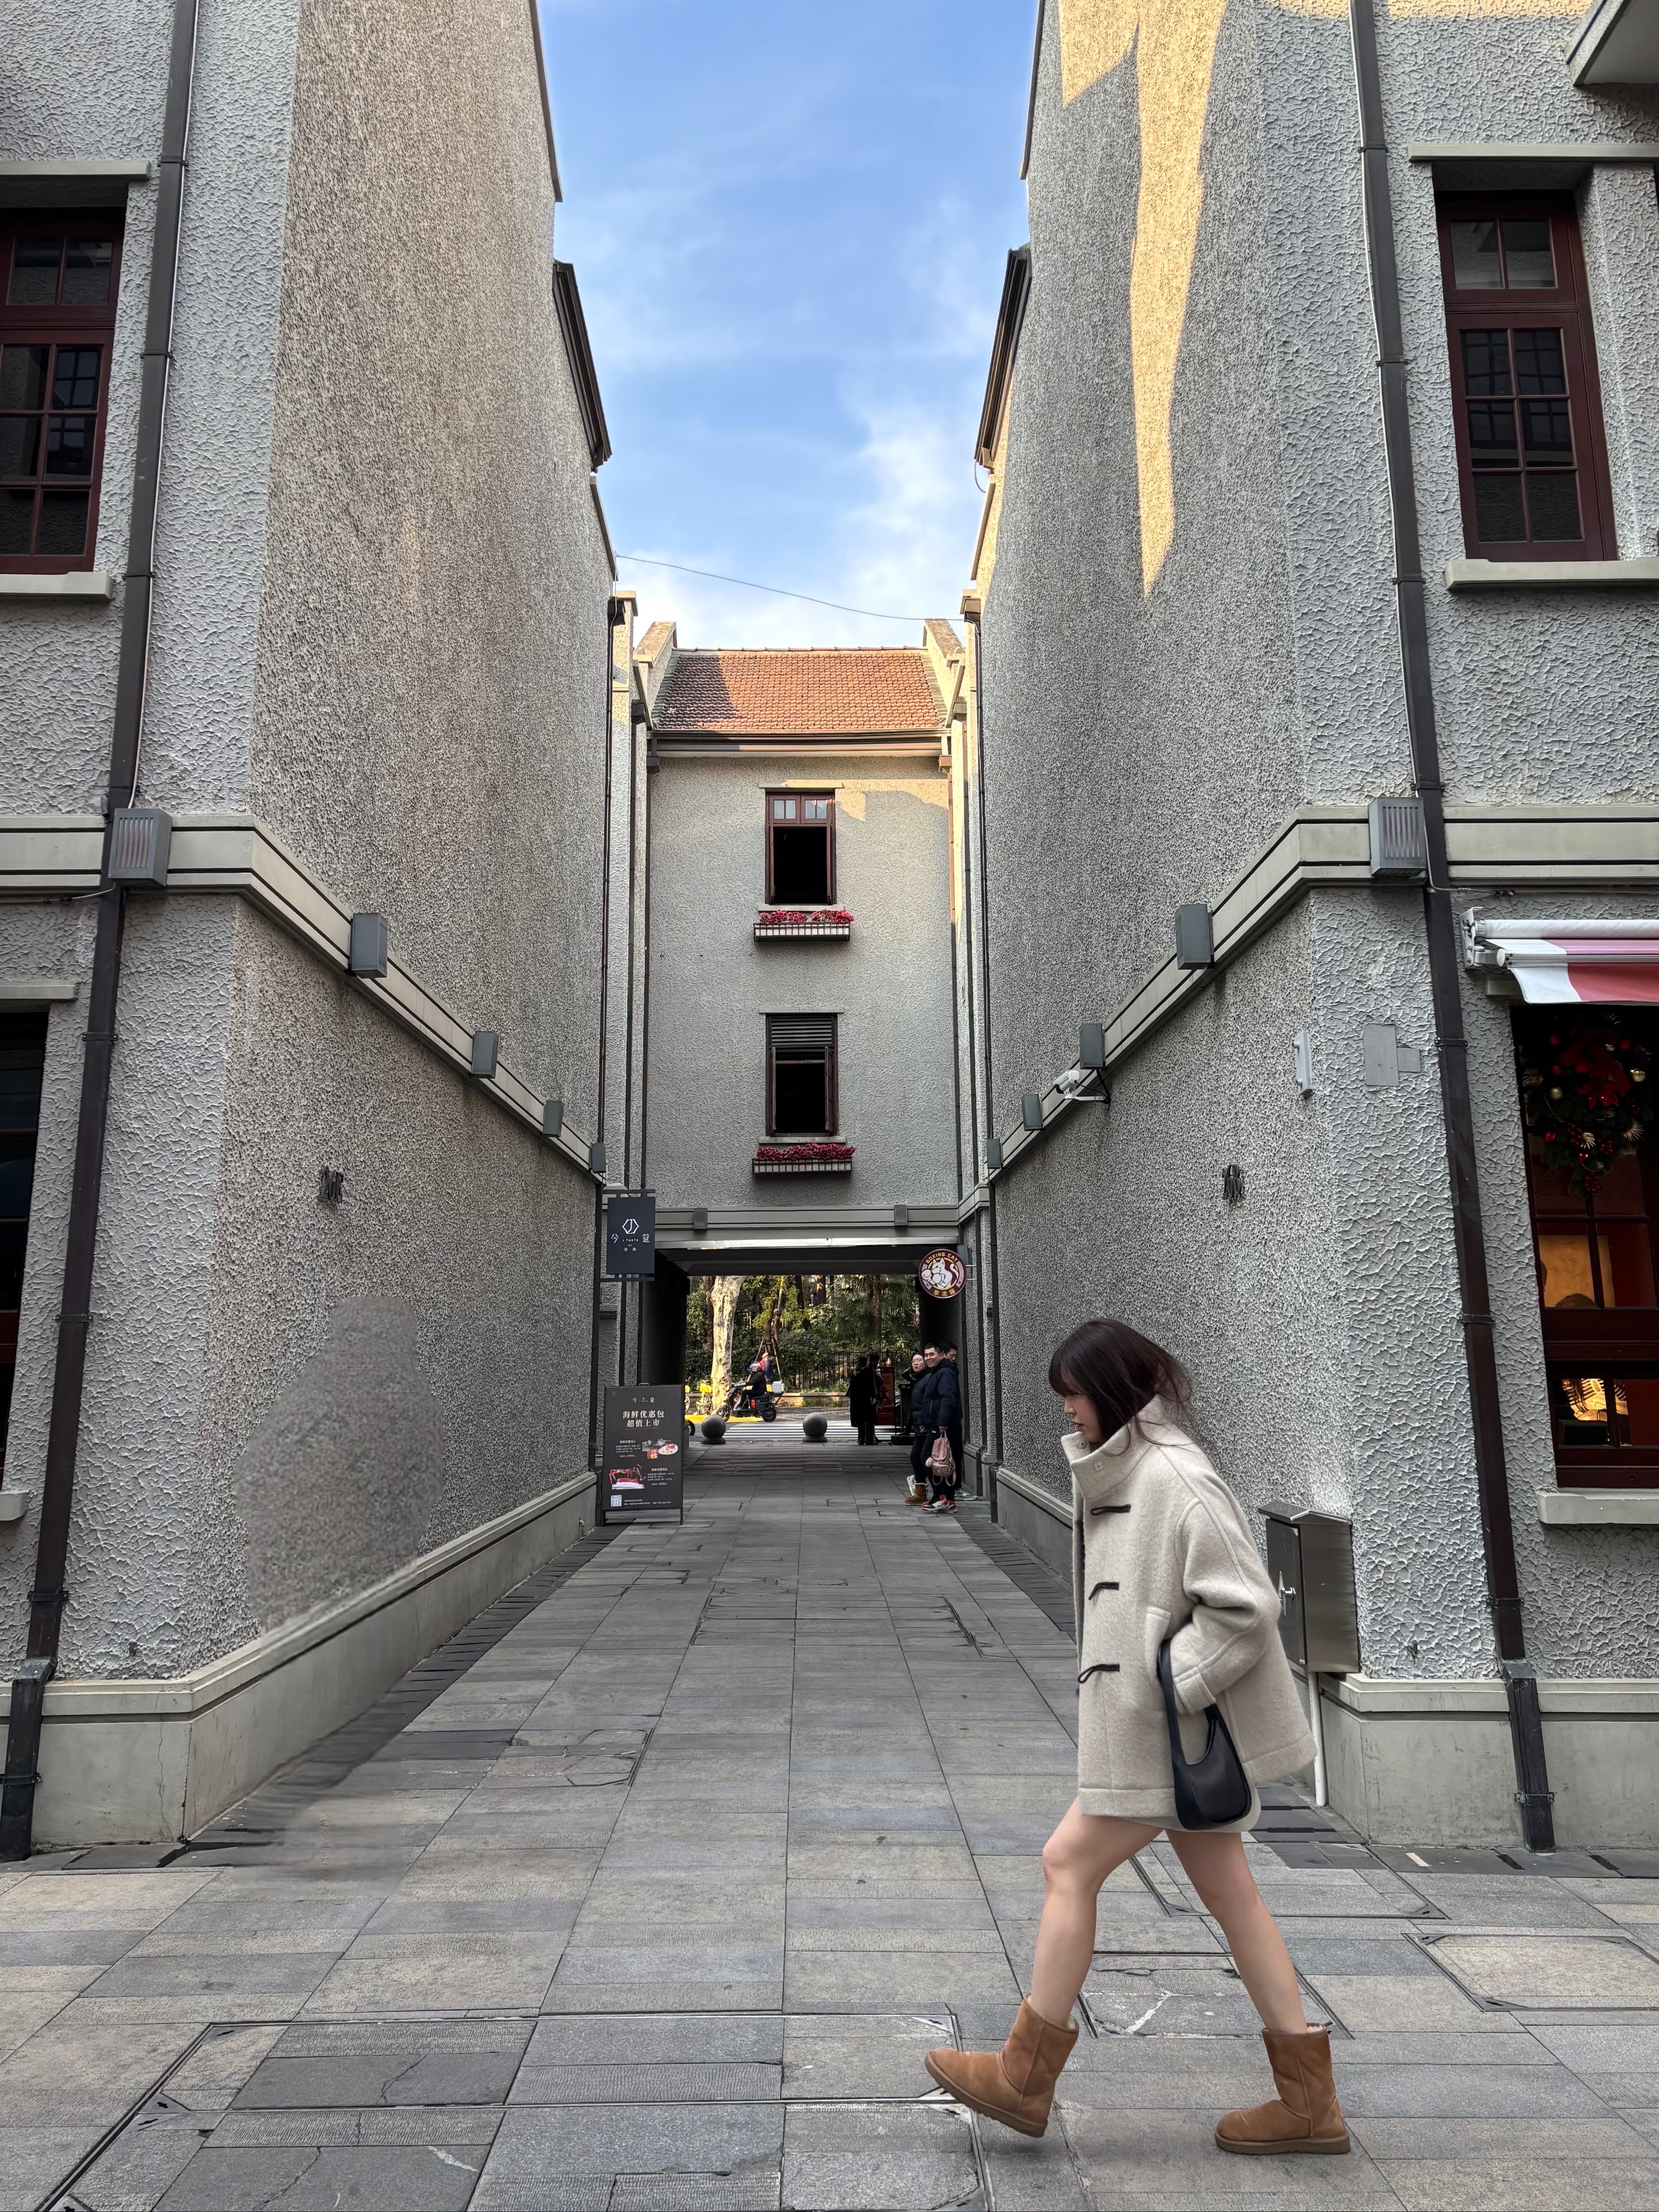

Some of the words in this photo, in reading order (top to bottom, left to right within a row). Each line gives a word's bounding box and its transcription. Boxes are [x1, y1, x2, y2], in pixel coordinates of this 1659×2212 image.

[926, 1252, 945, 1263] BOXING
[947, 1253, 958, 1262] CAT
[623, 1410, 664, 1419] 海鲜优惠包
[627, 1419, 660, 1427] 超值上市
